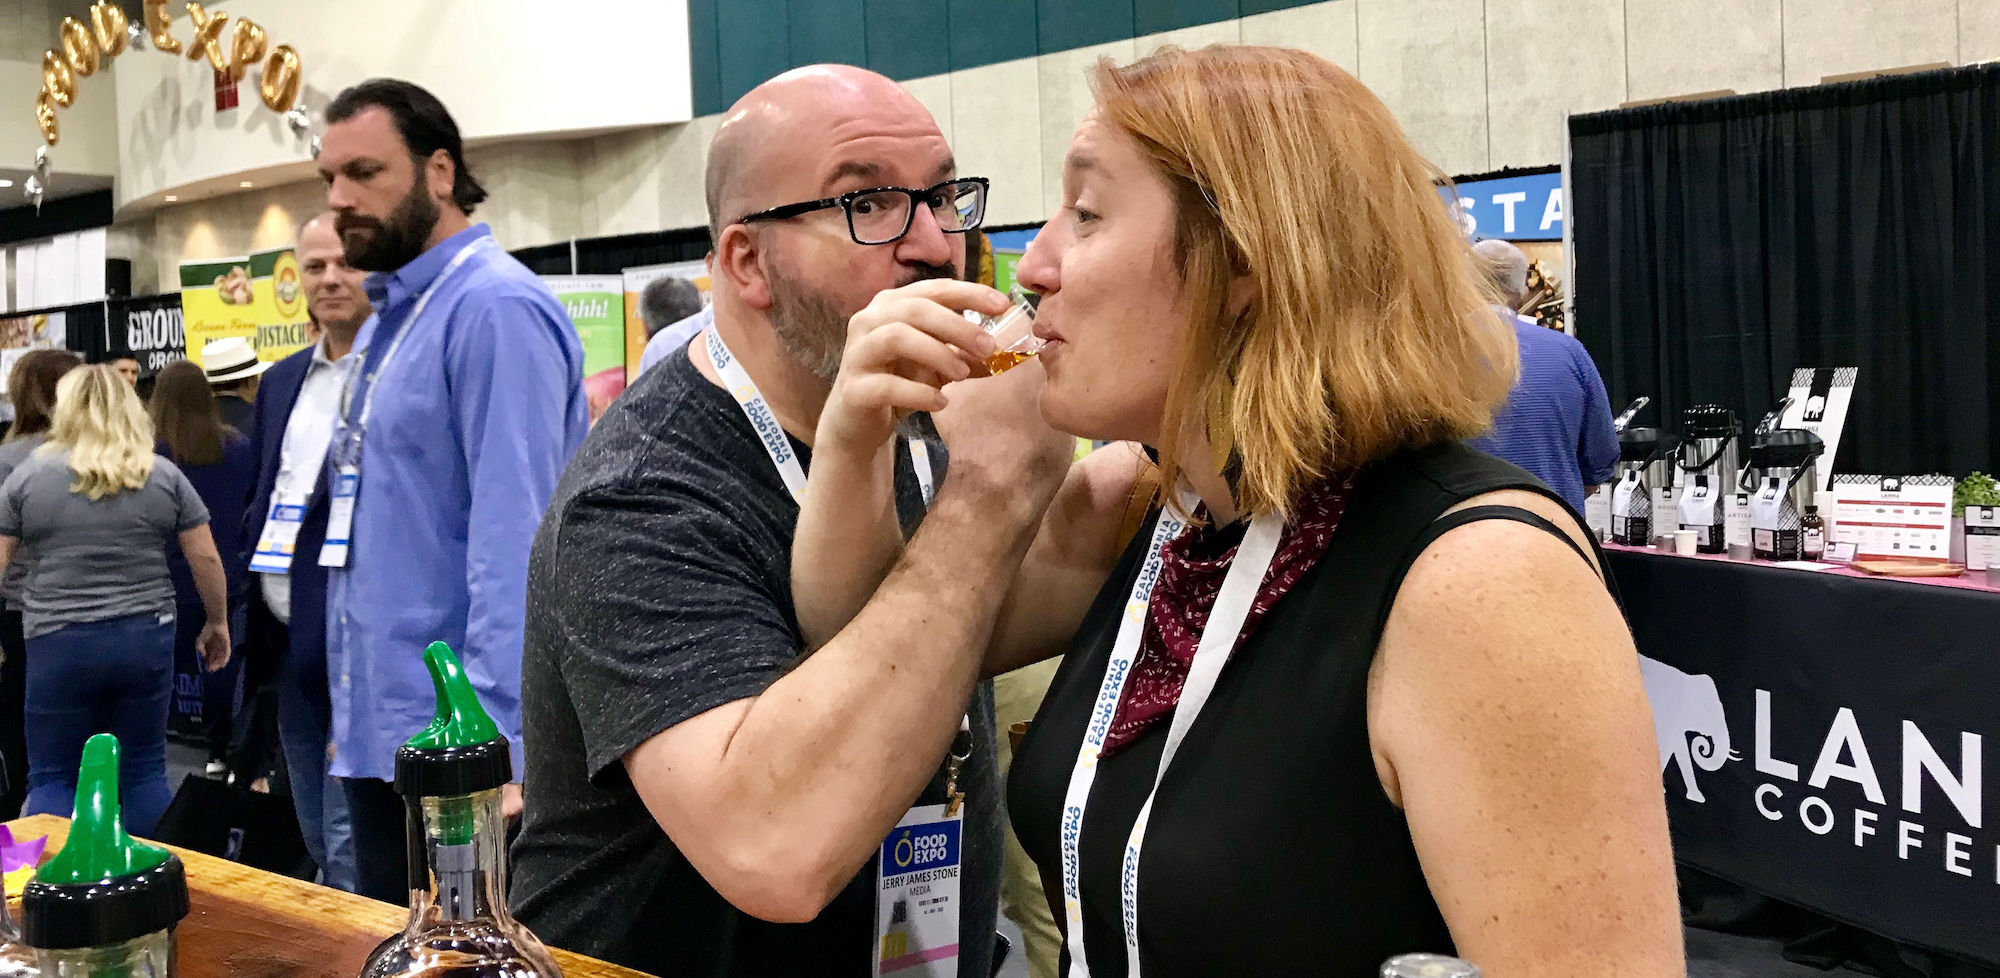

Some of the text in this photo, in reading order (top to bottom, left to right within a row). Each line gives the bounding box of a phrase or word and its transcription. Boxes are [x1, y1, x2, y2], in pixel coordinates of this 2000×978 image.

[144, 0, 302, 113] EXPO
[744, 402, 785, 464] FOOD EXPO
[753, 398, 791, 460] CALIFORNIA
[1136, 520, 1171, 600] CALIFORNIA
[1143, 521, 1181, 601] FOOD PO
[1088, 659, 1120, 743] CALIFORNIA
[1094, 659, 1129, 746] FOOD EXPO
[1755, 688, 1982, 828] LAN
[913, 847, 947, 864] EXPO
[914, 833, 948, 850] FOOD
[1063, 806, 1074, 896] CALIFORNIA
[1069, 806, 1081, 900] FOOD EXPO
[1123, 846, 1134, 896] FOOD
[1755, 783, 2000, 885] COFFE
[882, 867, 959, 890] JERRY JAMES STONE
[909, 885, 931, 896] MEDIA
